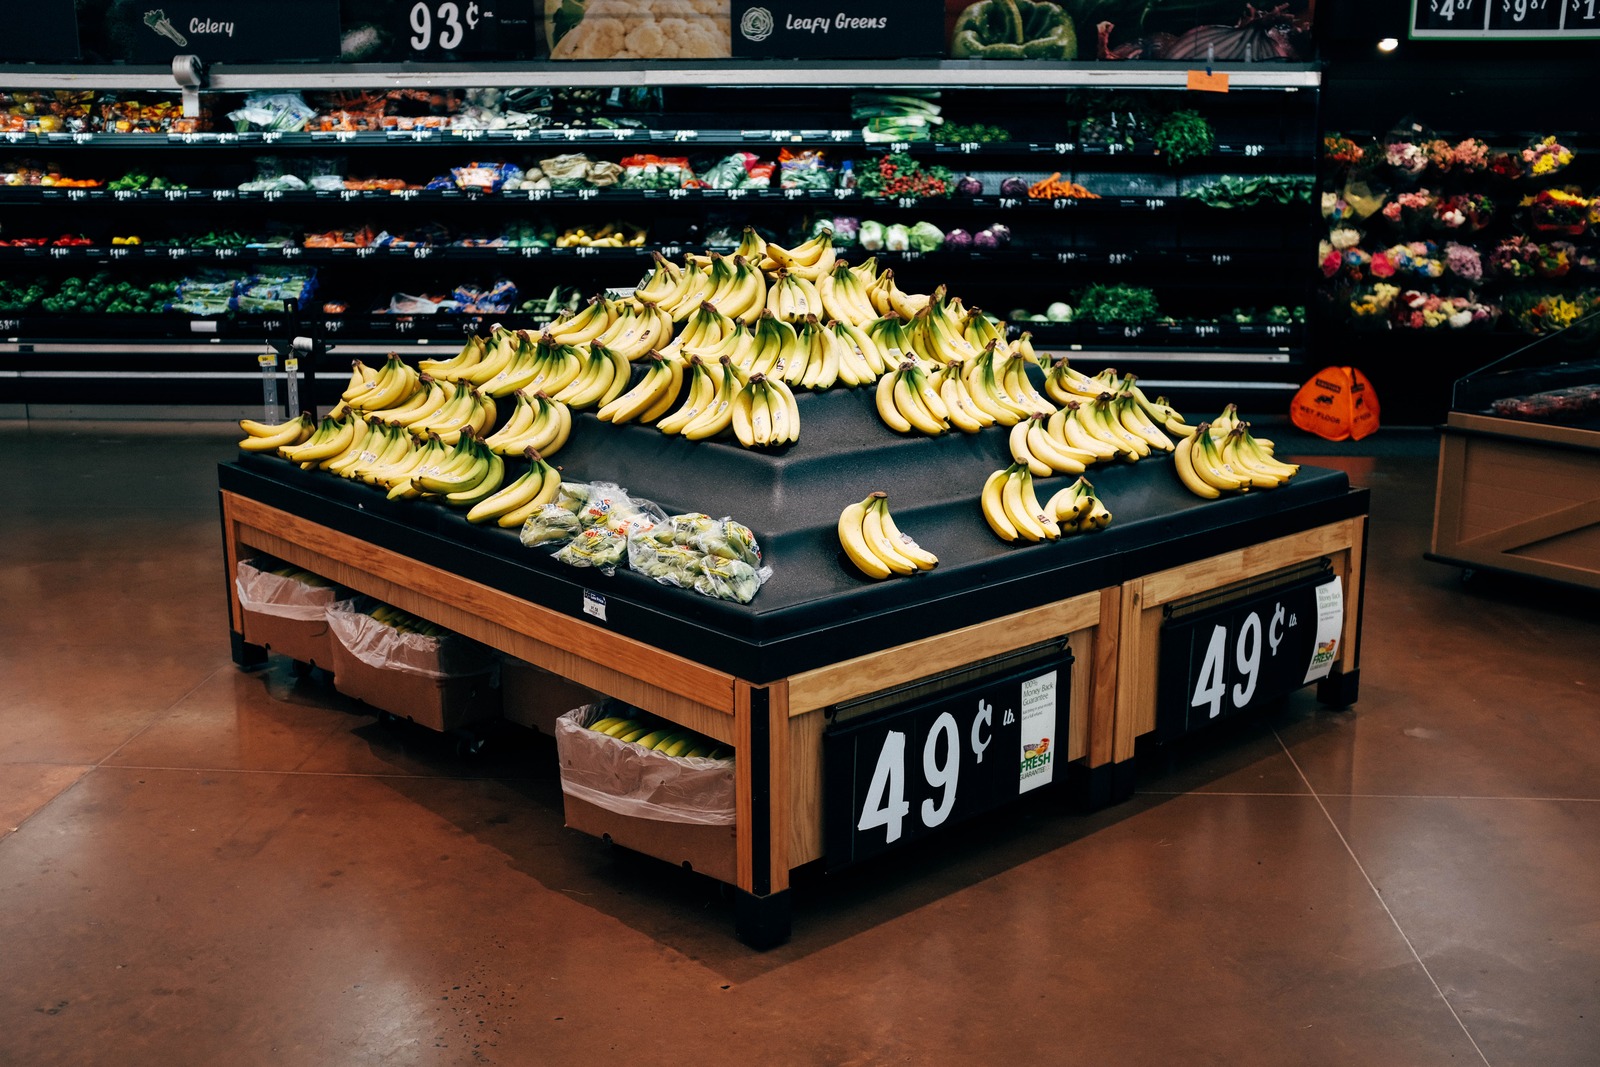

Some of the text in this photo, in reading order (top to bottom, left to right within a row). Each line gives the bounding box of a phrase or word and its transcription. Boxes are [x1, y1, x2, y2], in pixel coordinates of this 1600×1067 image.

[189, 17, 235, 38] Celery
[409, 1, 479, 50] 93¢
[786, 12, 888, 34] Leafy Greens
[1191, 602, 1297, 719] 49¢ lb.
[1023, 682, 1054, 698] Money Back
[1023, 692, 1049, 706] Guarantee
[857, 699, 1015, 844] 49¢ lb.
[1020, 751, 1051, 773] FRESH
